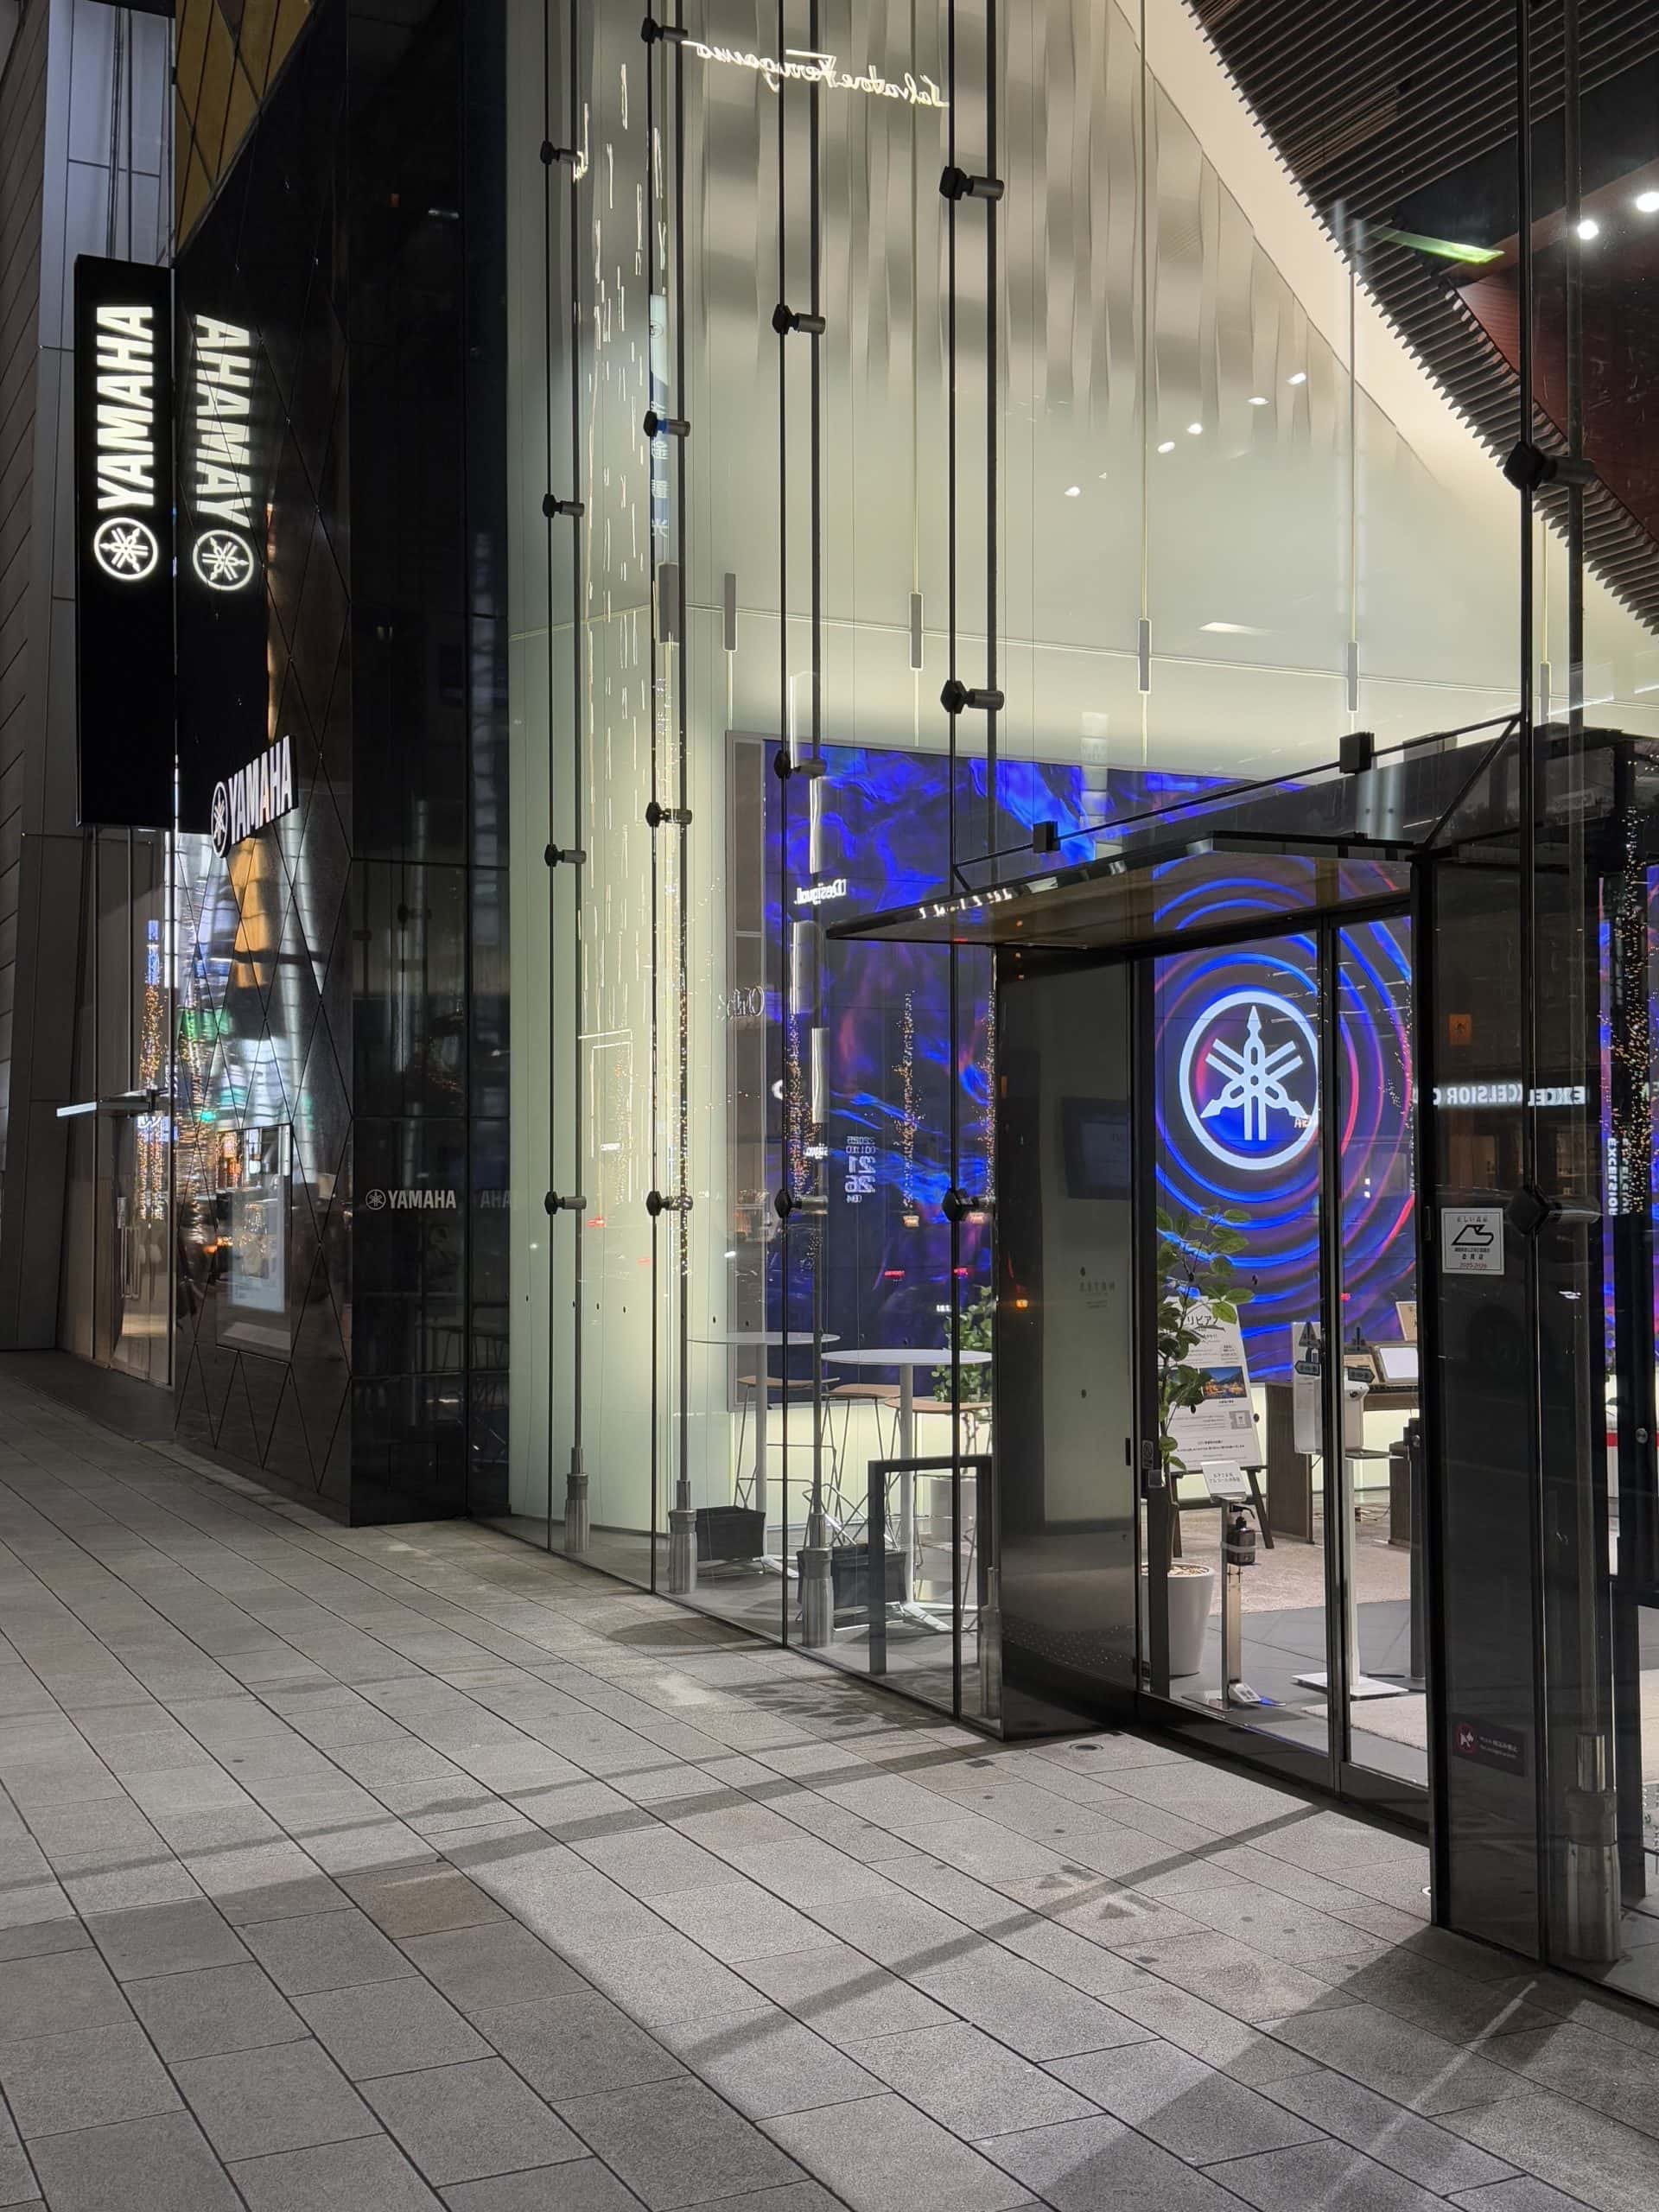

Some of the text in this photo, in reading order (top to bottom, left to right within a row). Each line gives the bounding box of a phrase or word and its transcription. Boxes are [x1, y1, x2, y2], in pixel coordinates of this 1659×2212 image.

[97, 306, 154, 510] YAMAHA
[227, 735, 294, 844] YAMAHA
[388, 1189, 457, 1209] YAMAHA
